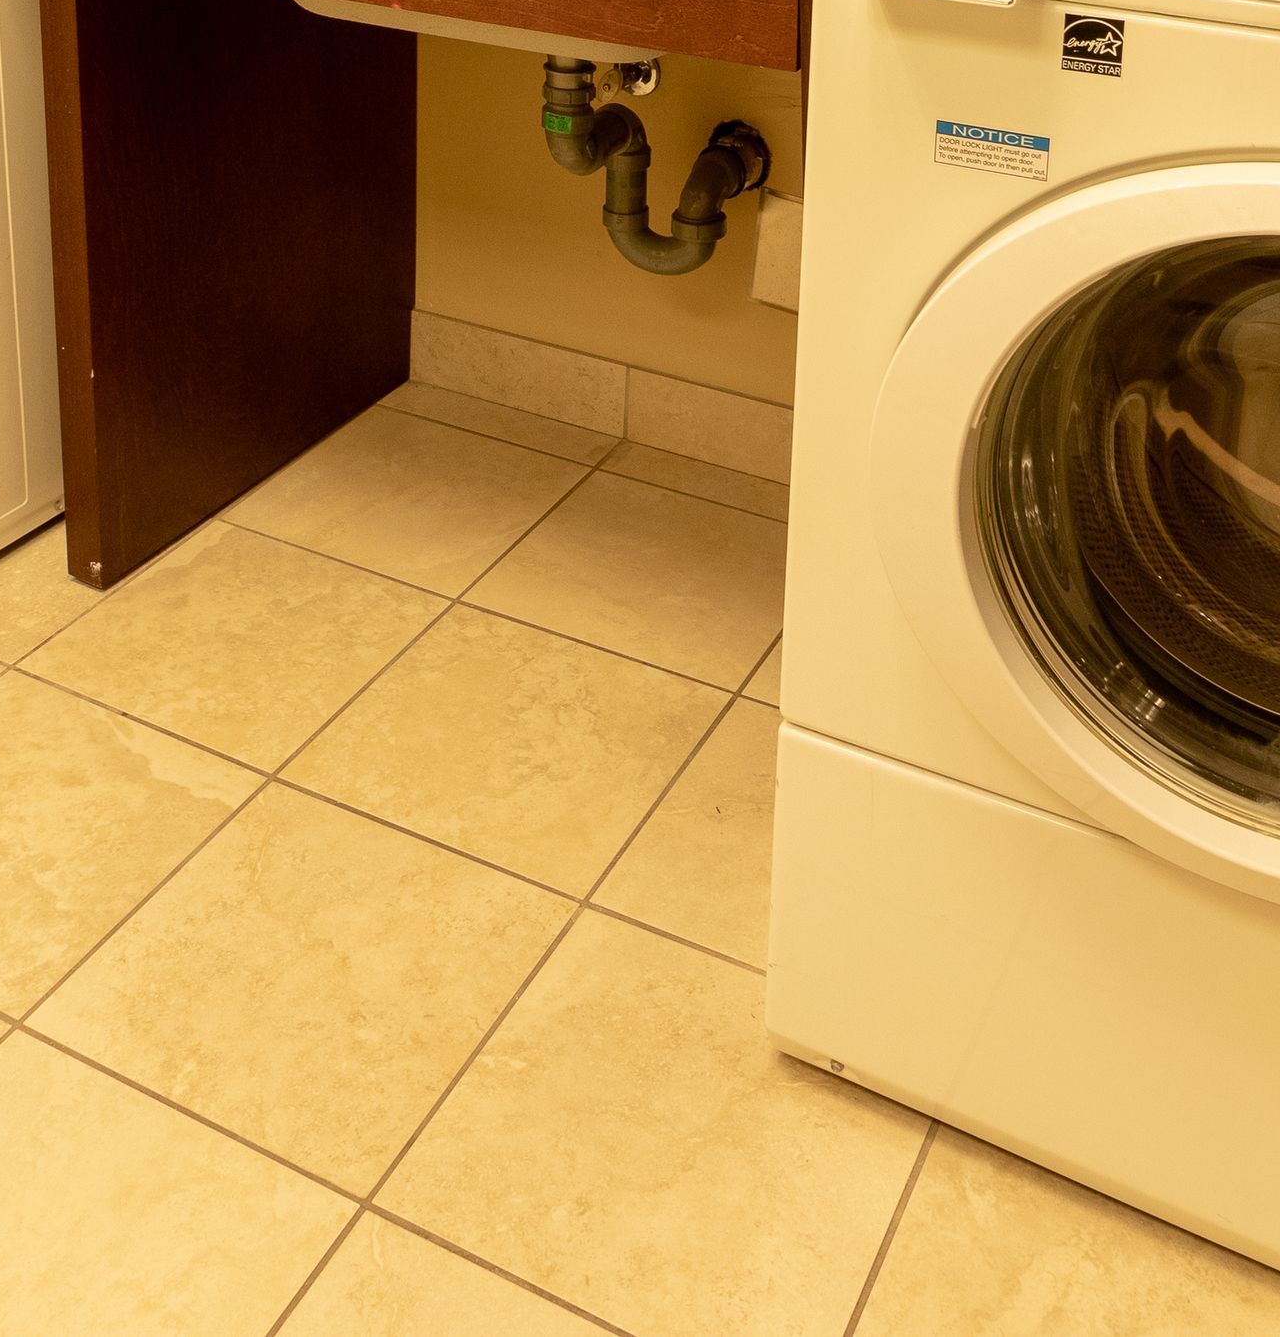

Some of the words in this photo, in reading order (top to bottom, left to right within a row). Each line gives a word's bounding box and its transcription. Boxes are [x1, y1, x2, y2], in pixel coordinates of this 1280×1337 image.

[1062, 60, 1096, 72] ENERGY
[1097, 64, 1121, 76] STAR
[952, 124, 1033, 147] NOTICE
